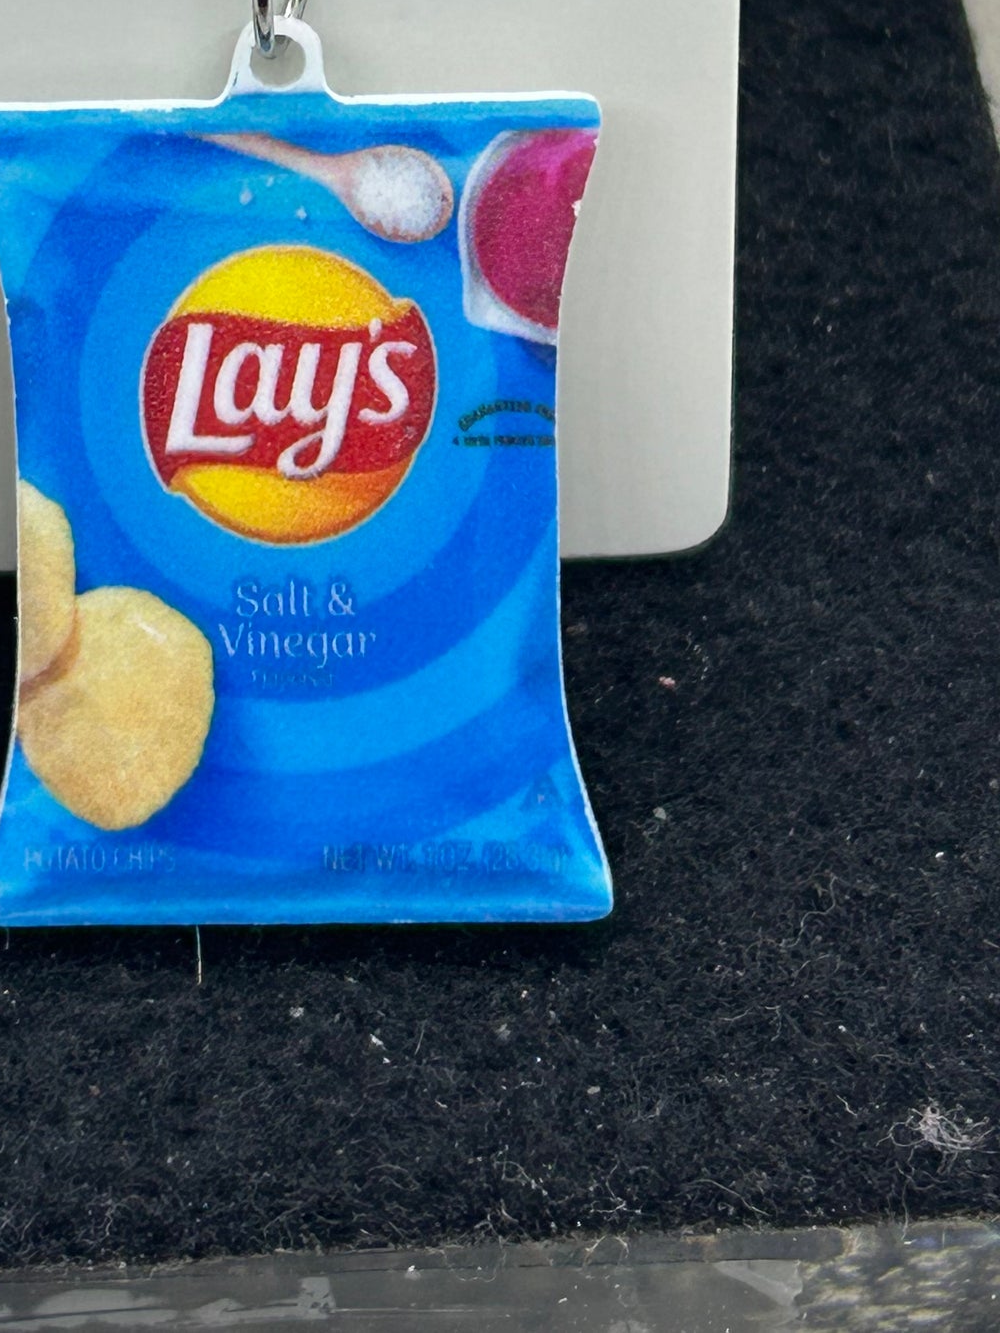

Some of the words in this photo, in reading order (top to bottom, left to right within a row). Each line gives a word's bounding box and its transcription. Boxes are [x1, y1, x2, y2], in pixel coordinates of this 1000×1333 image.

[165, 318, 417, 479] Lay's
[236, 580, 311, 617] Salt
[328, 581, 356, 616] &
[218, 622, 377, 669] Vinegar
